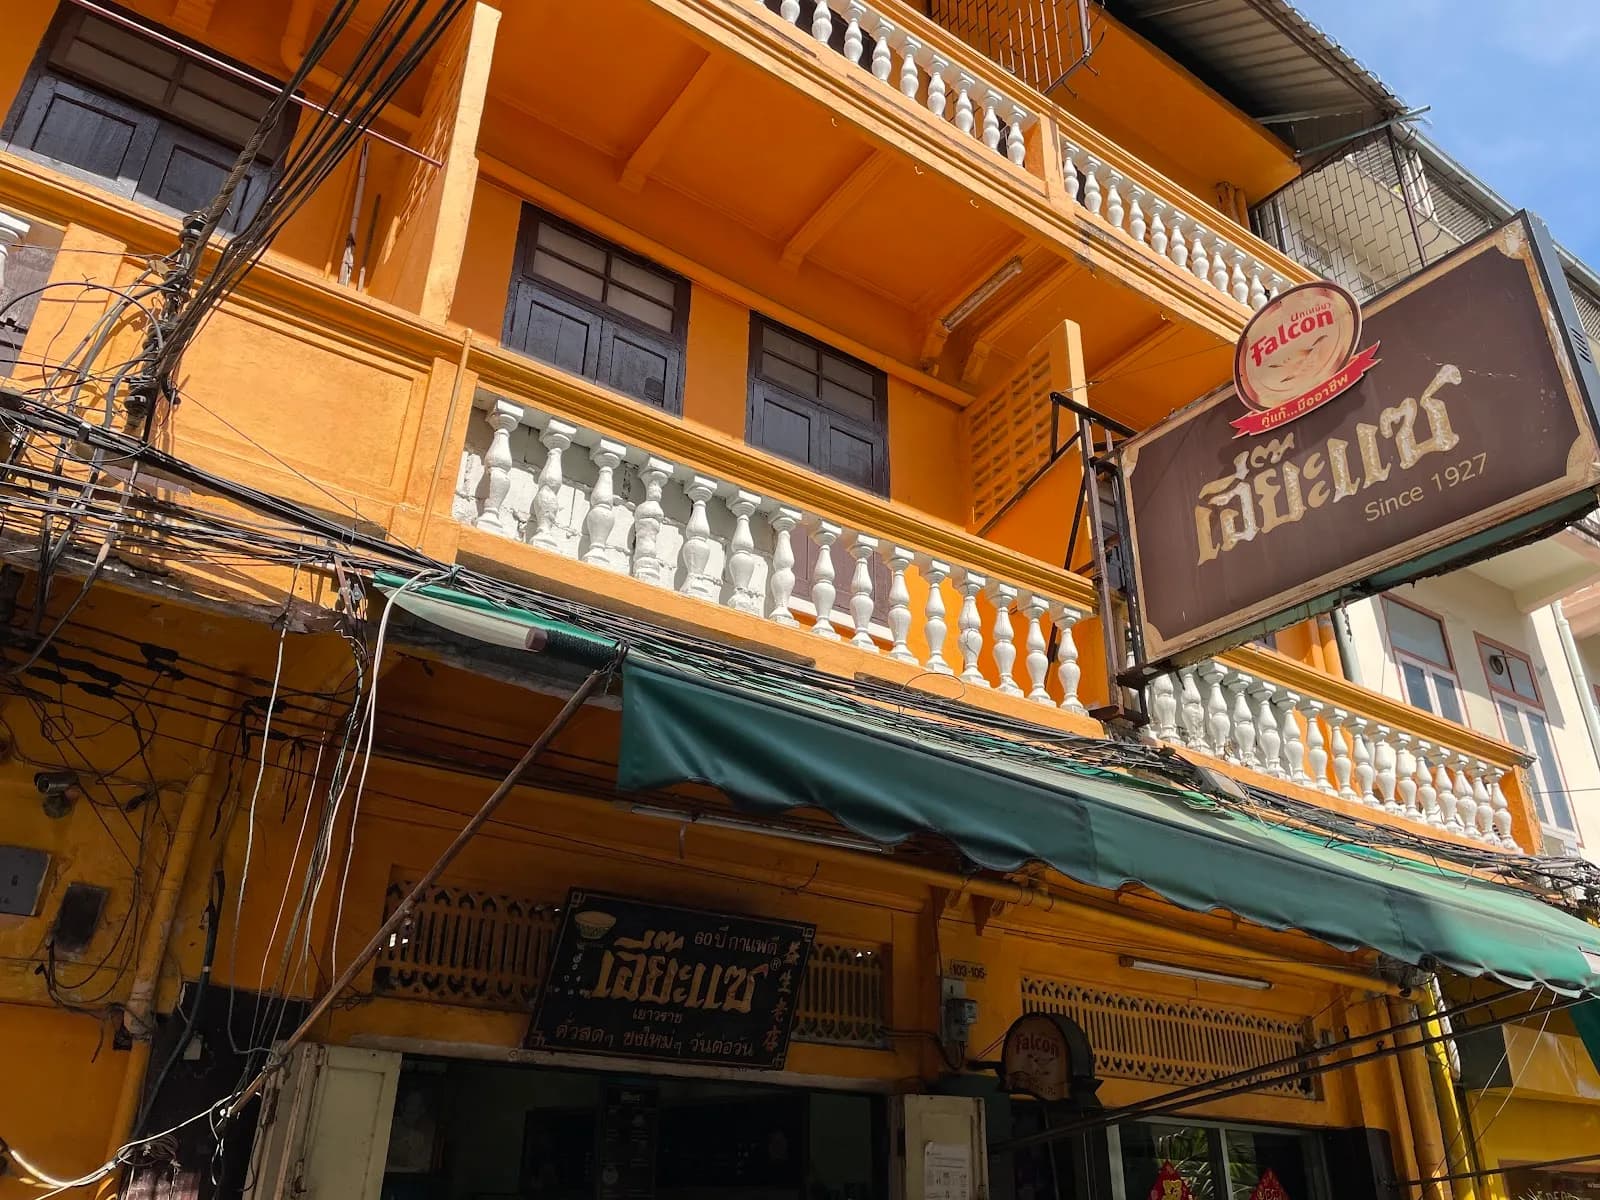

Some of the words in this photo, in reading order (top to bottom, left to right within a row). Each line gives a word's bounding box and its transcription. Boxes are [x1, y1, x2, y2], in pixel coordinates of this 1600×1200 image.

[1249, 309, 1334, 367] Falcon
[1195, 363, 1463, 566] เอี๊ยะแซ
[1364, 480, 1425, 522] Since
[1430, 452, 1488, 493] 1927
